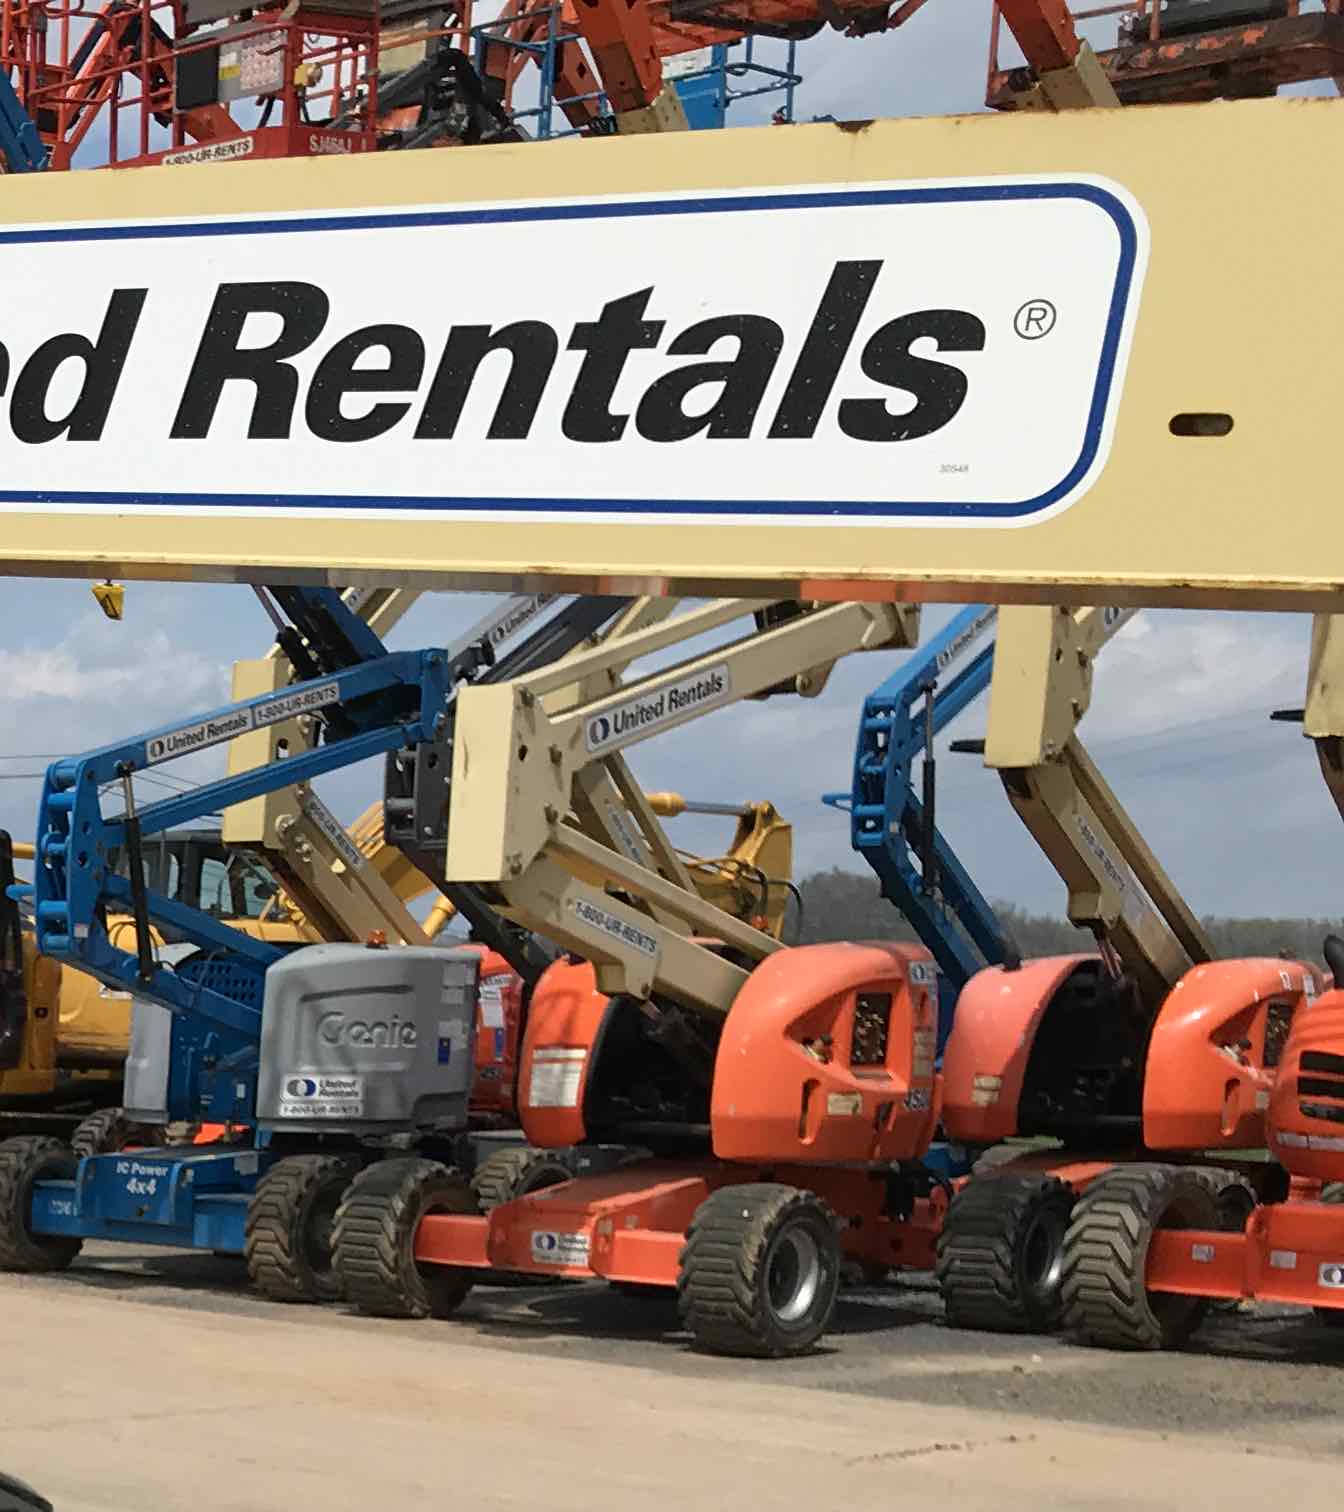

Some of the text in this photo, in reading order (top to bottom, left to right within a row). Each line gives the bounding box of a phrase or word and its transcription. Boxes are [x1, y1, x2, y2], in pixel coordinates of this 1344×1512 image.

[169, 260, 986, 443] Rentals
[613, 671, 723, 734] United Rentals
[166, 713, 248, 752] United Rentals
[318, 1010, 417, 1048] Genie
[126, 1177, 157, 1195] 4x4
[131, 1162, 169, 1177] Power
